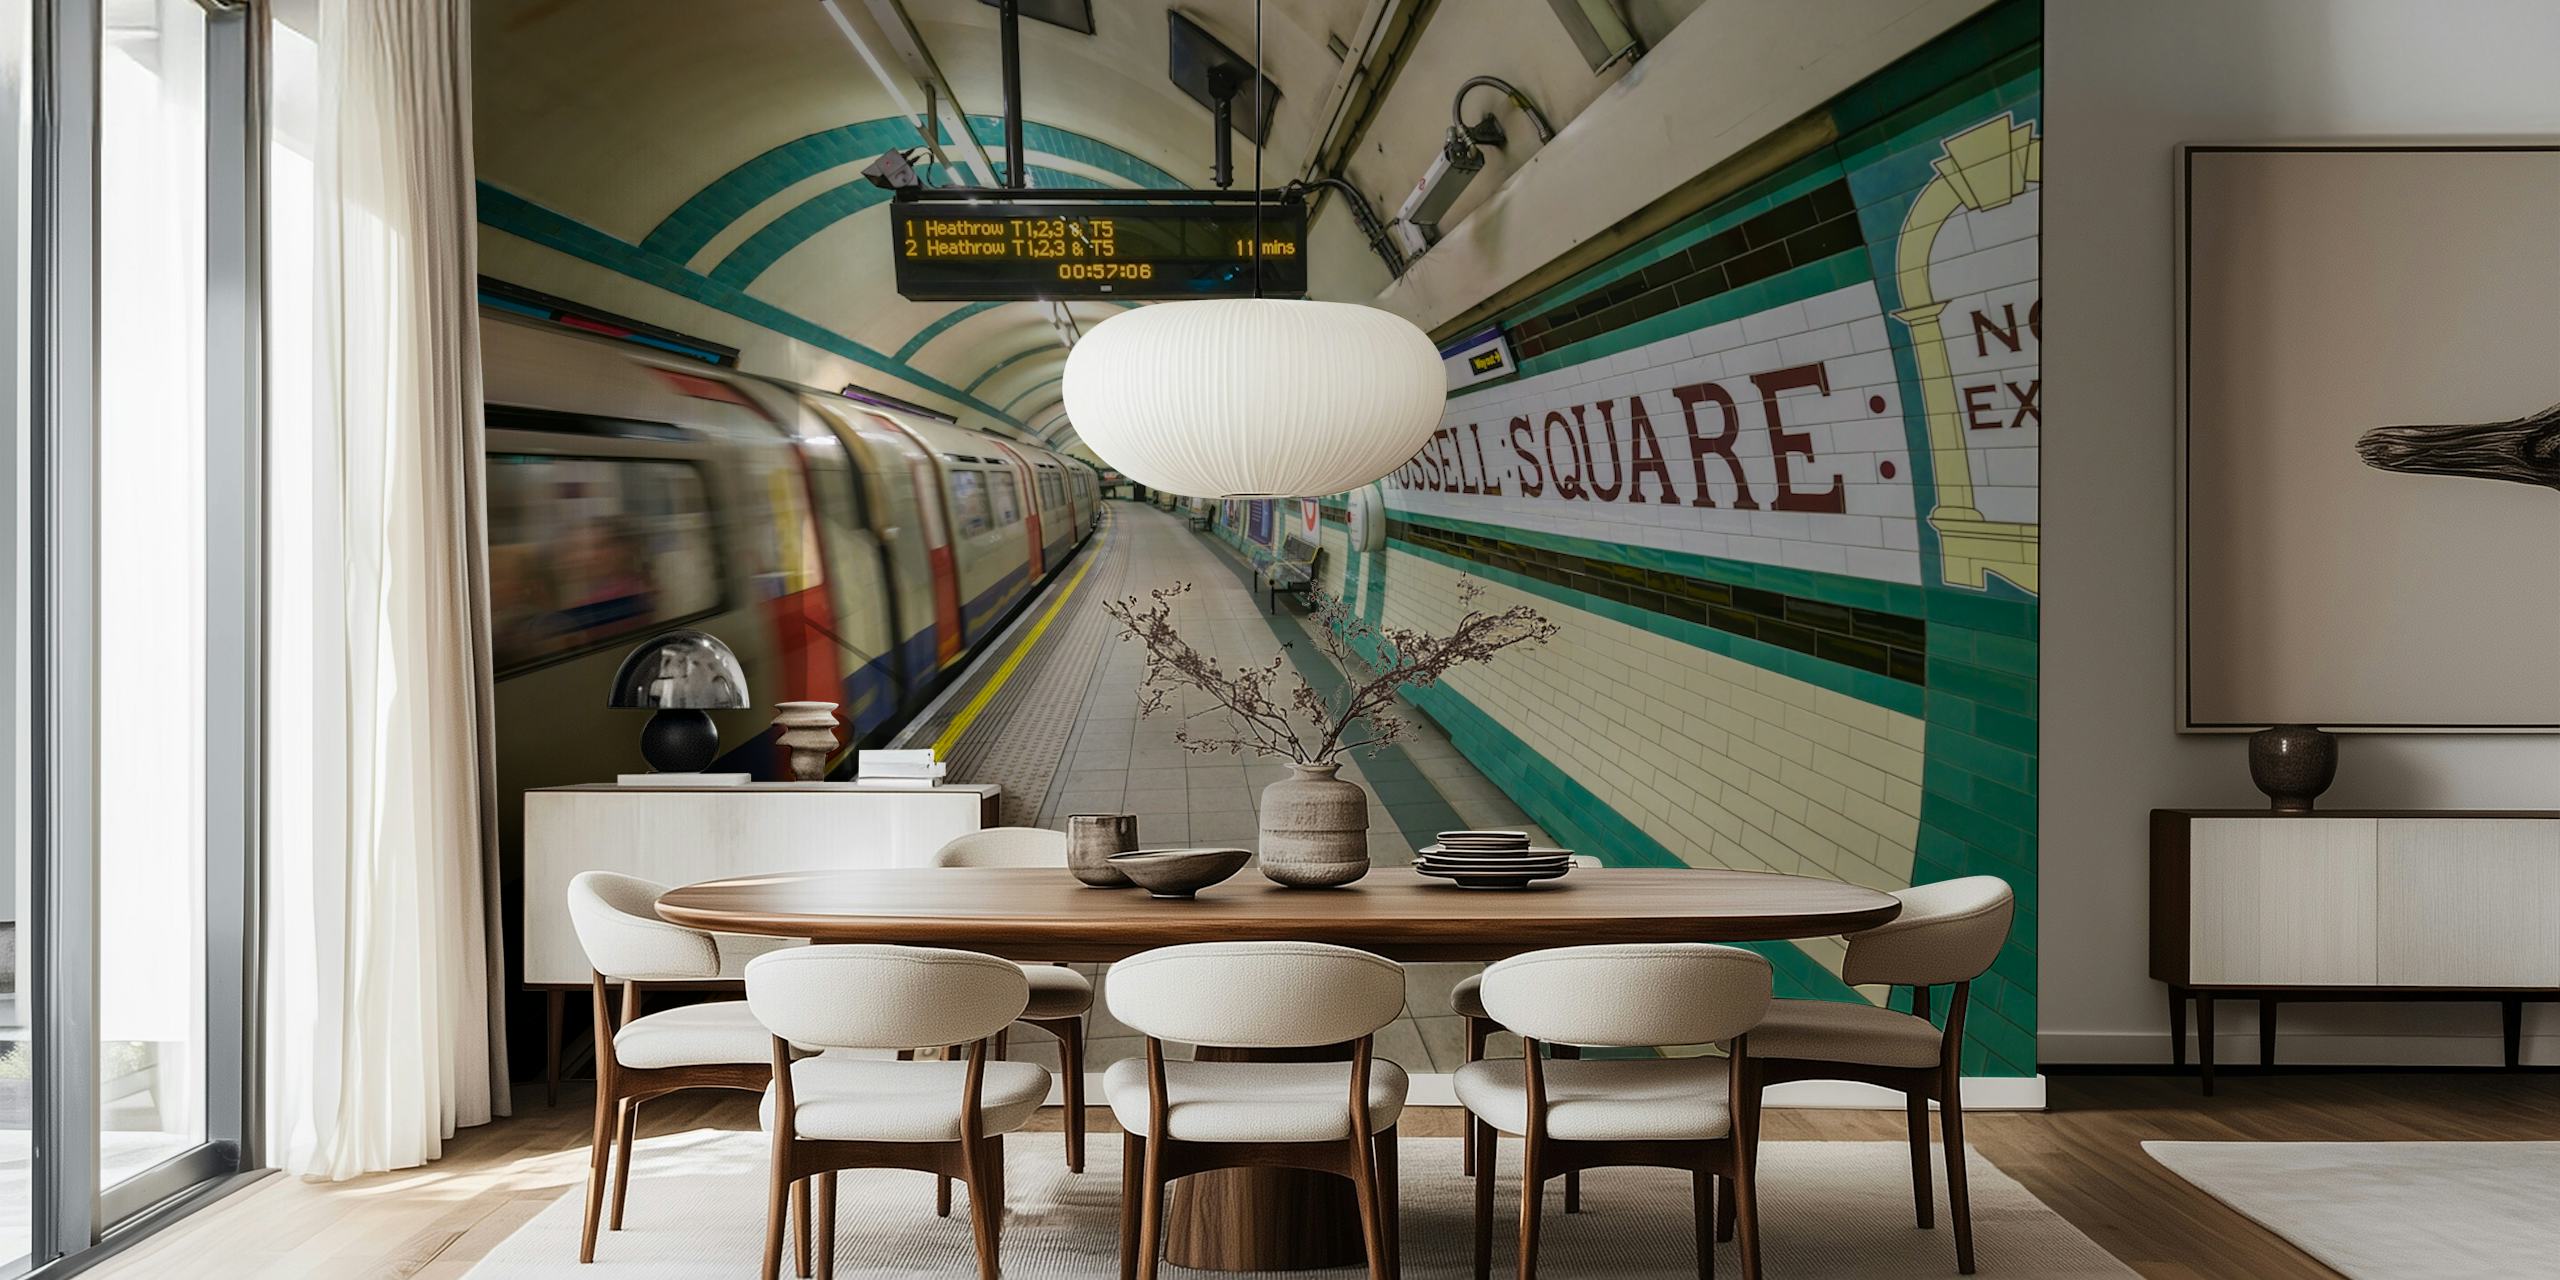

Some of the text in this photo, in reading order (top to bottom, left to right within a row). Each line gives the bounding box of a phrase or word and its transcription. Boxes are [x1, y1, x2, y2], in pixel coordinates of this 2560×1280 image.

[906, 220, 1114, 239] 1 Heathrow T1,2,3 & T5
[905, 239, 1296, 258] 2 Heathrow T1,2,3 & T5 11 mins
[1059, 263, 1152, 280] 00:57:06
[1387, 423, 1502, 497] USSELL
